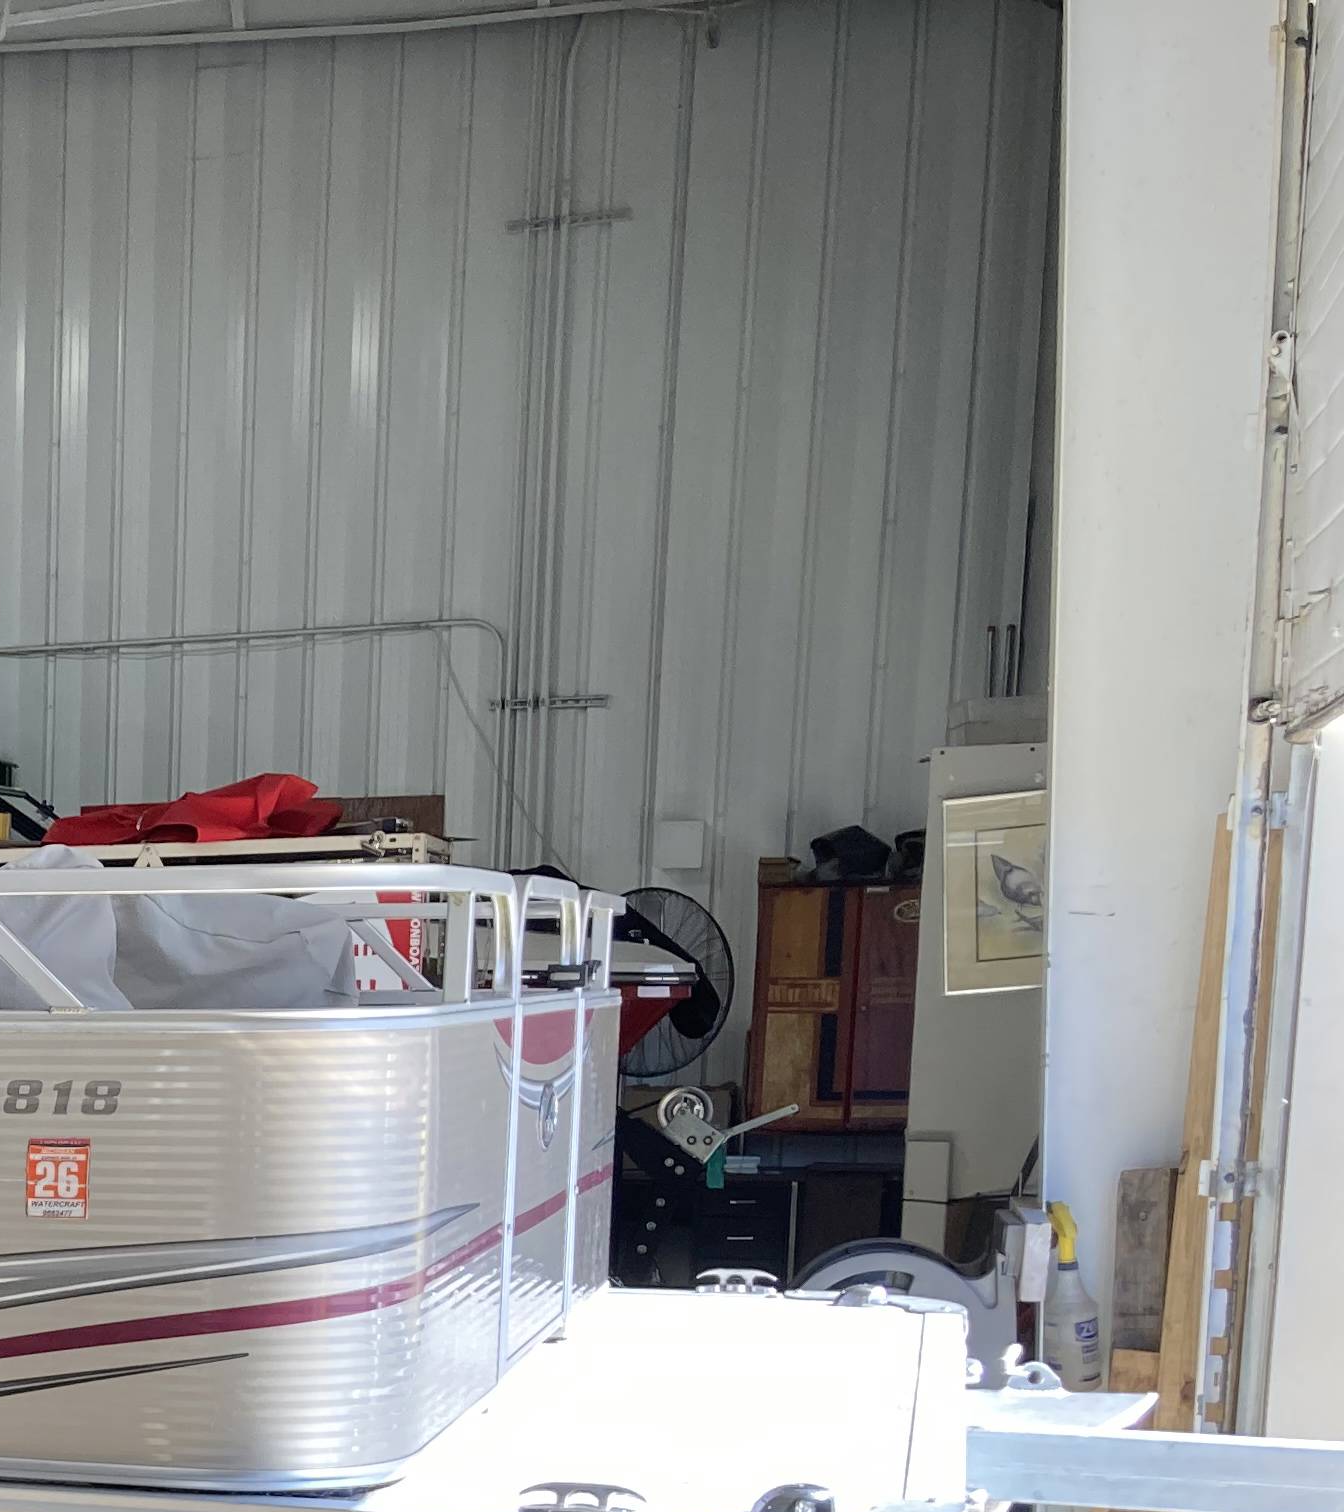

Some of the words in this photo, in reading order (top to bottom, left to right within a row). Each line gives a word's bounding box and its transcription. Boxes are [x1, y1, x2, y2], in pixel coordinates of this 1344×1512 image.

[2, 1079, 122, 1116] 818
[34, 1160, 80, 1199] 26
[30, 1200, 86, 1208] WATERCRAFT
